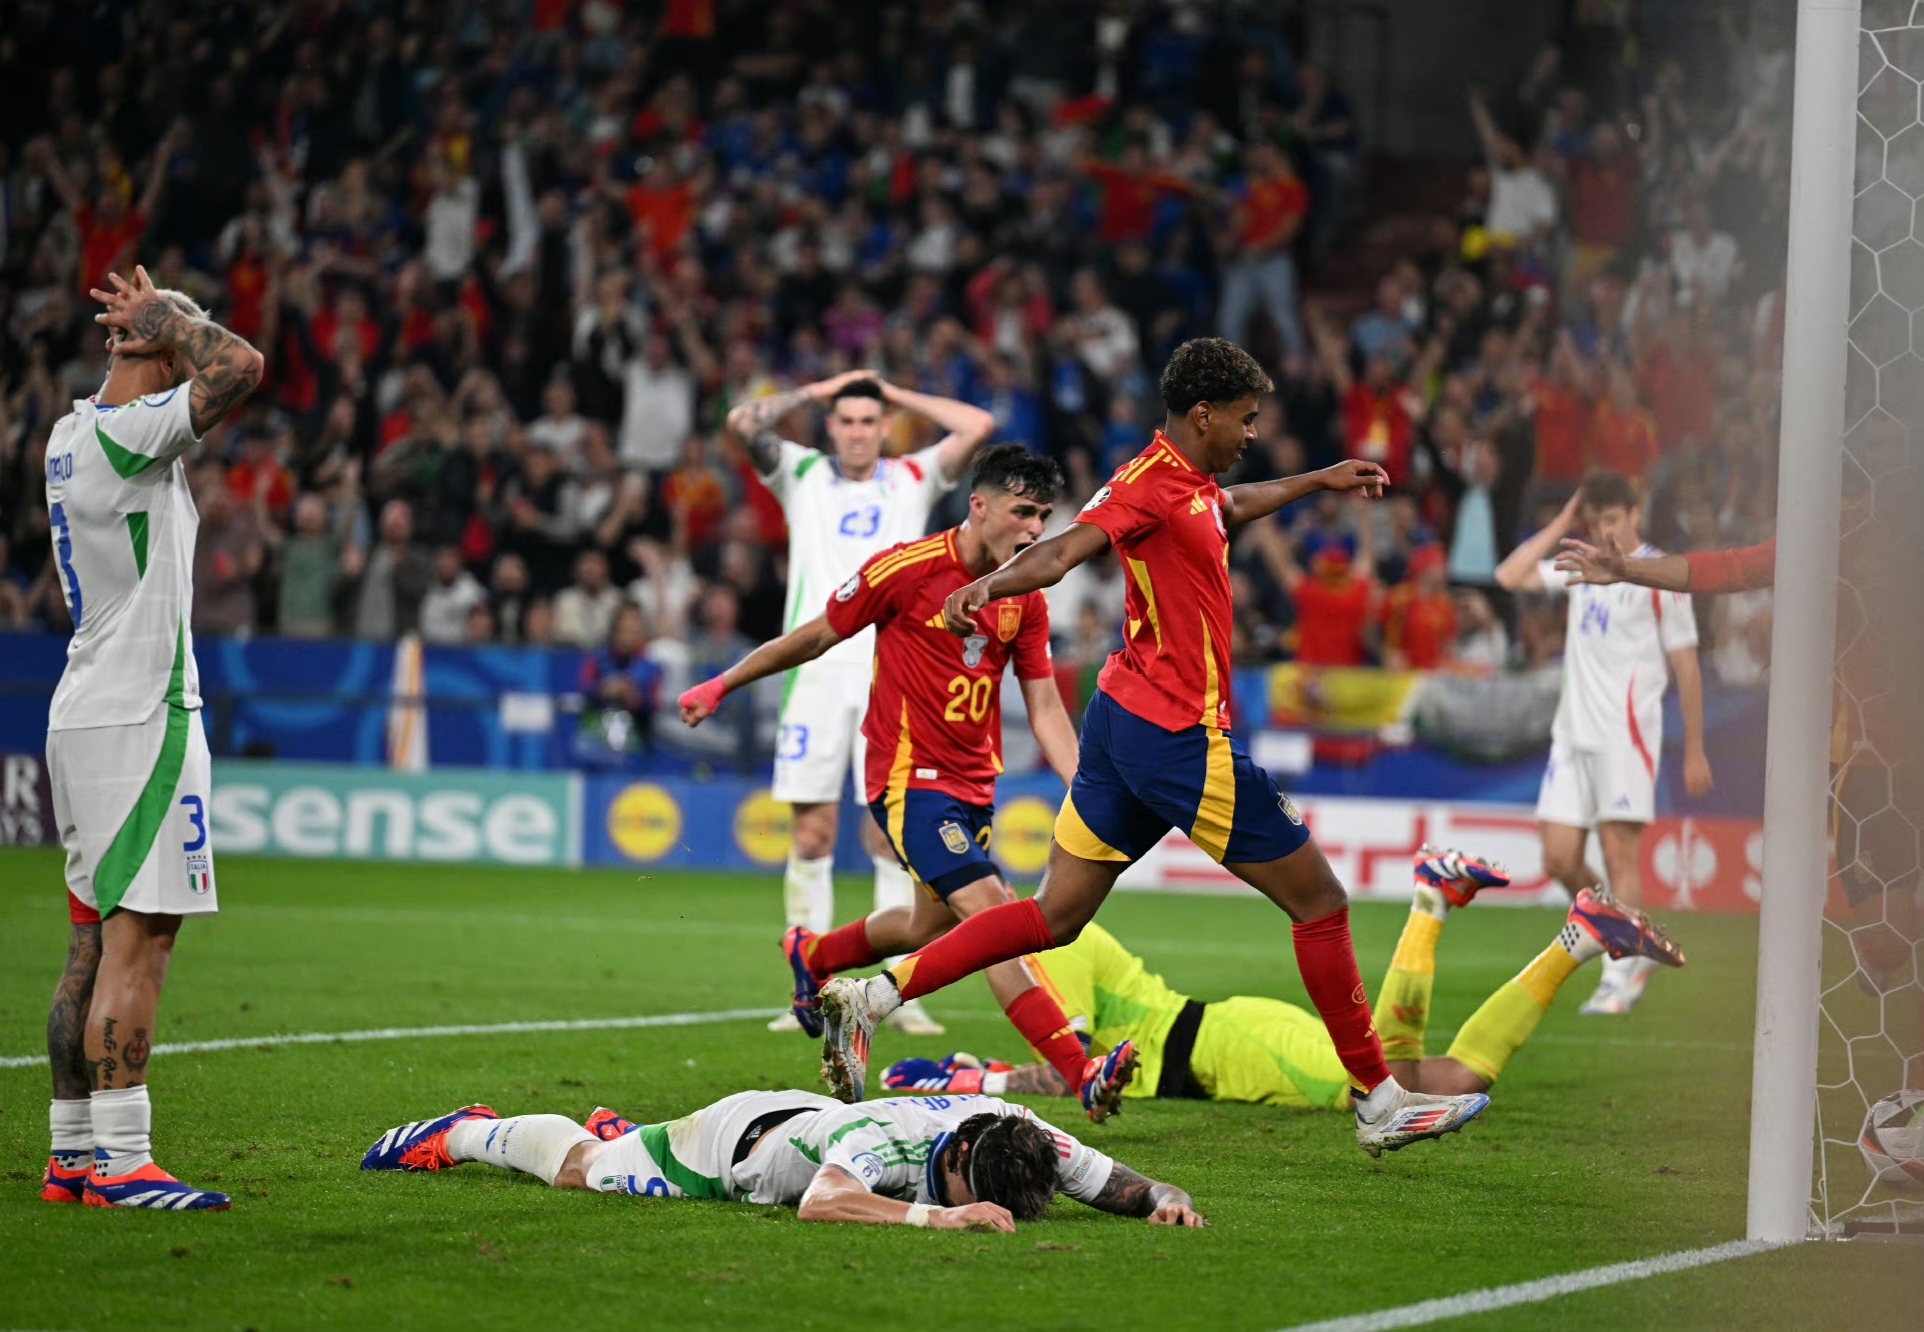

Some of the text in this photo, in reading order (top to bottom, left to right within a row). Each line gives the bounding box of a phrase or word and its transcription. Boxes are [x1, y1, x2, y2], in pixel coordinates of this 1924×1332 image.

[944, 674, 993, 723] 20
[180, 794, 207, 852] 3
[189, 863, 207, 871] ITALIA
